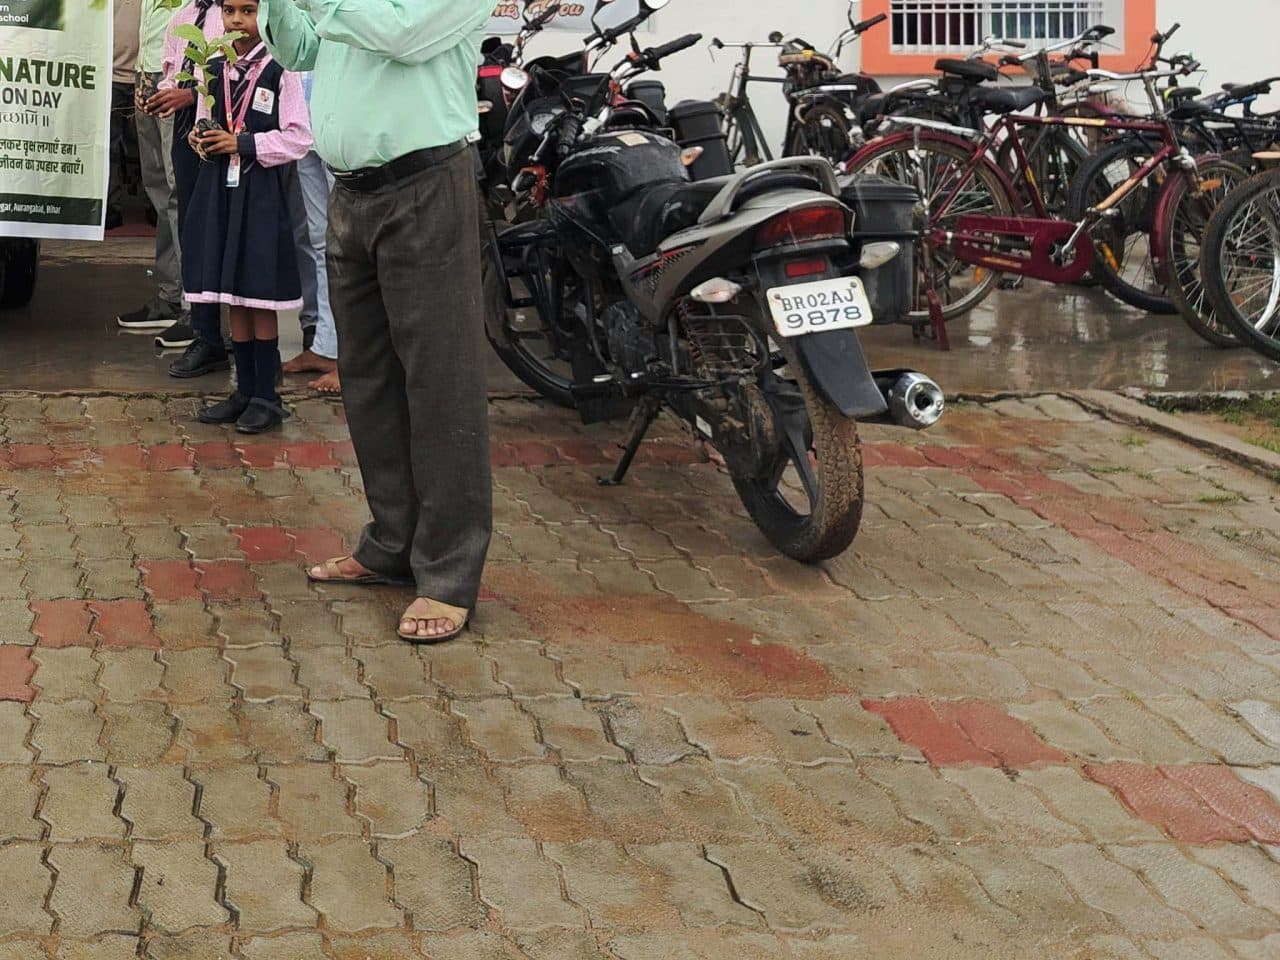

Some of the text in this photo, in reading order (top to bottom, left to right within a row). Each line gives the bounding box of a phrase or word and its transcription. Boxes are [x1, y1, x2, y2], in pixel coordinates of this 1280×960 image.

[32, 90, 62, 108] DAY
[781, 289, 854, 311] BR02AJ
[786, 306, 862, 329] 9878
